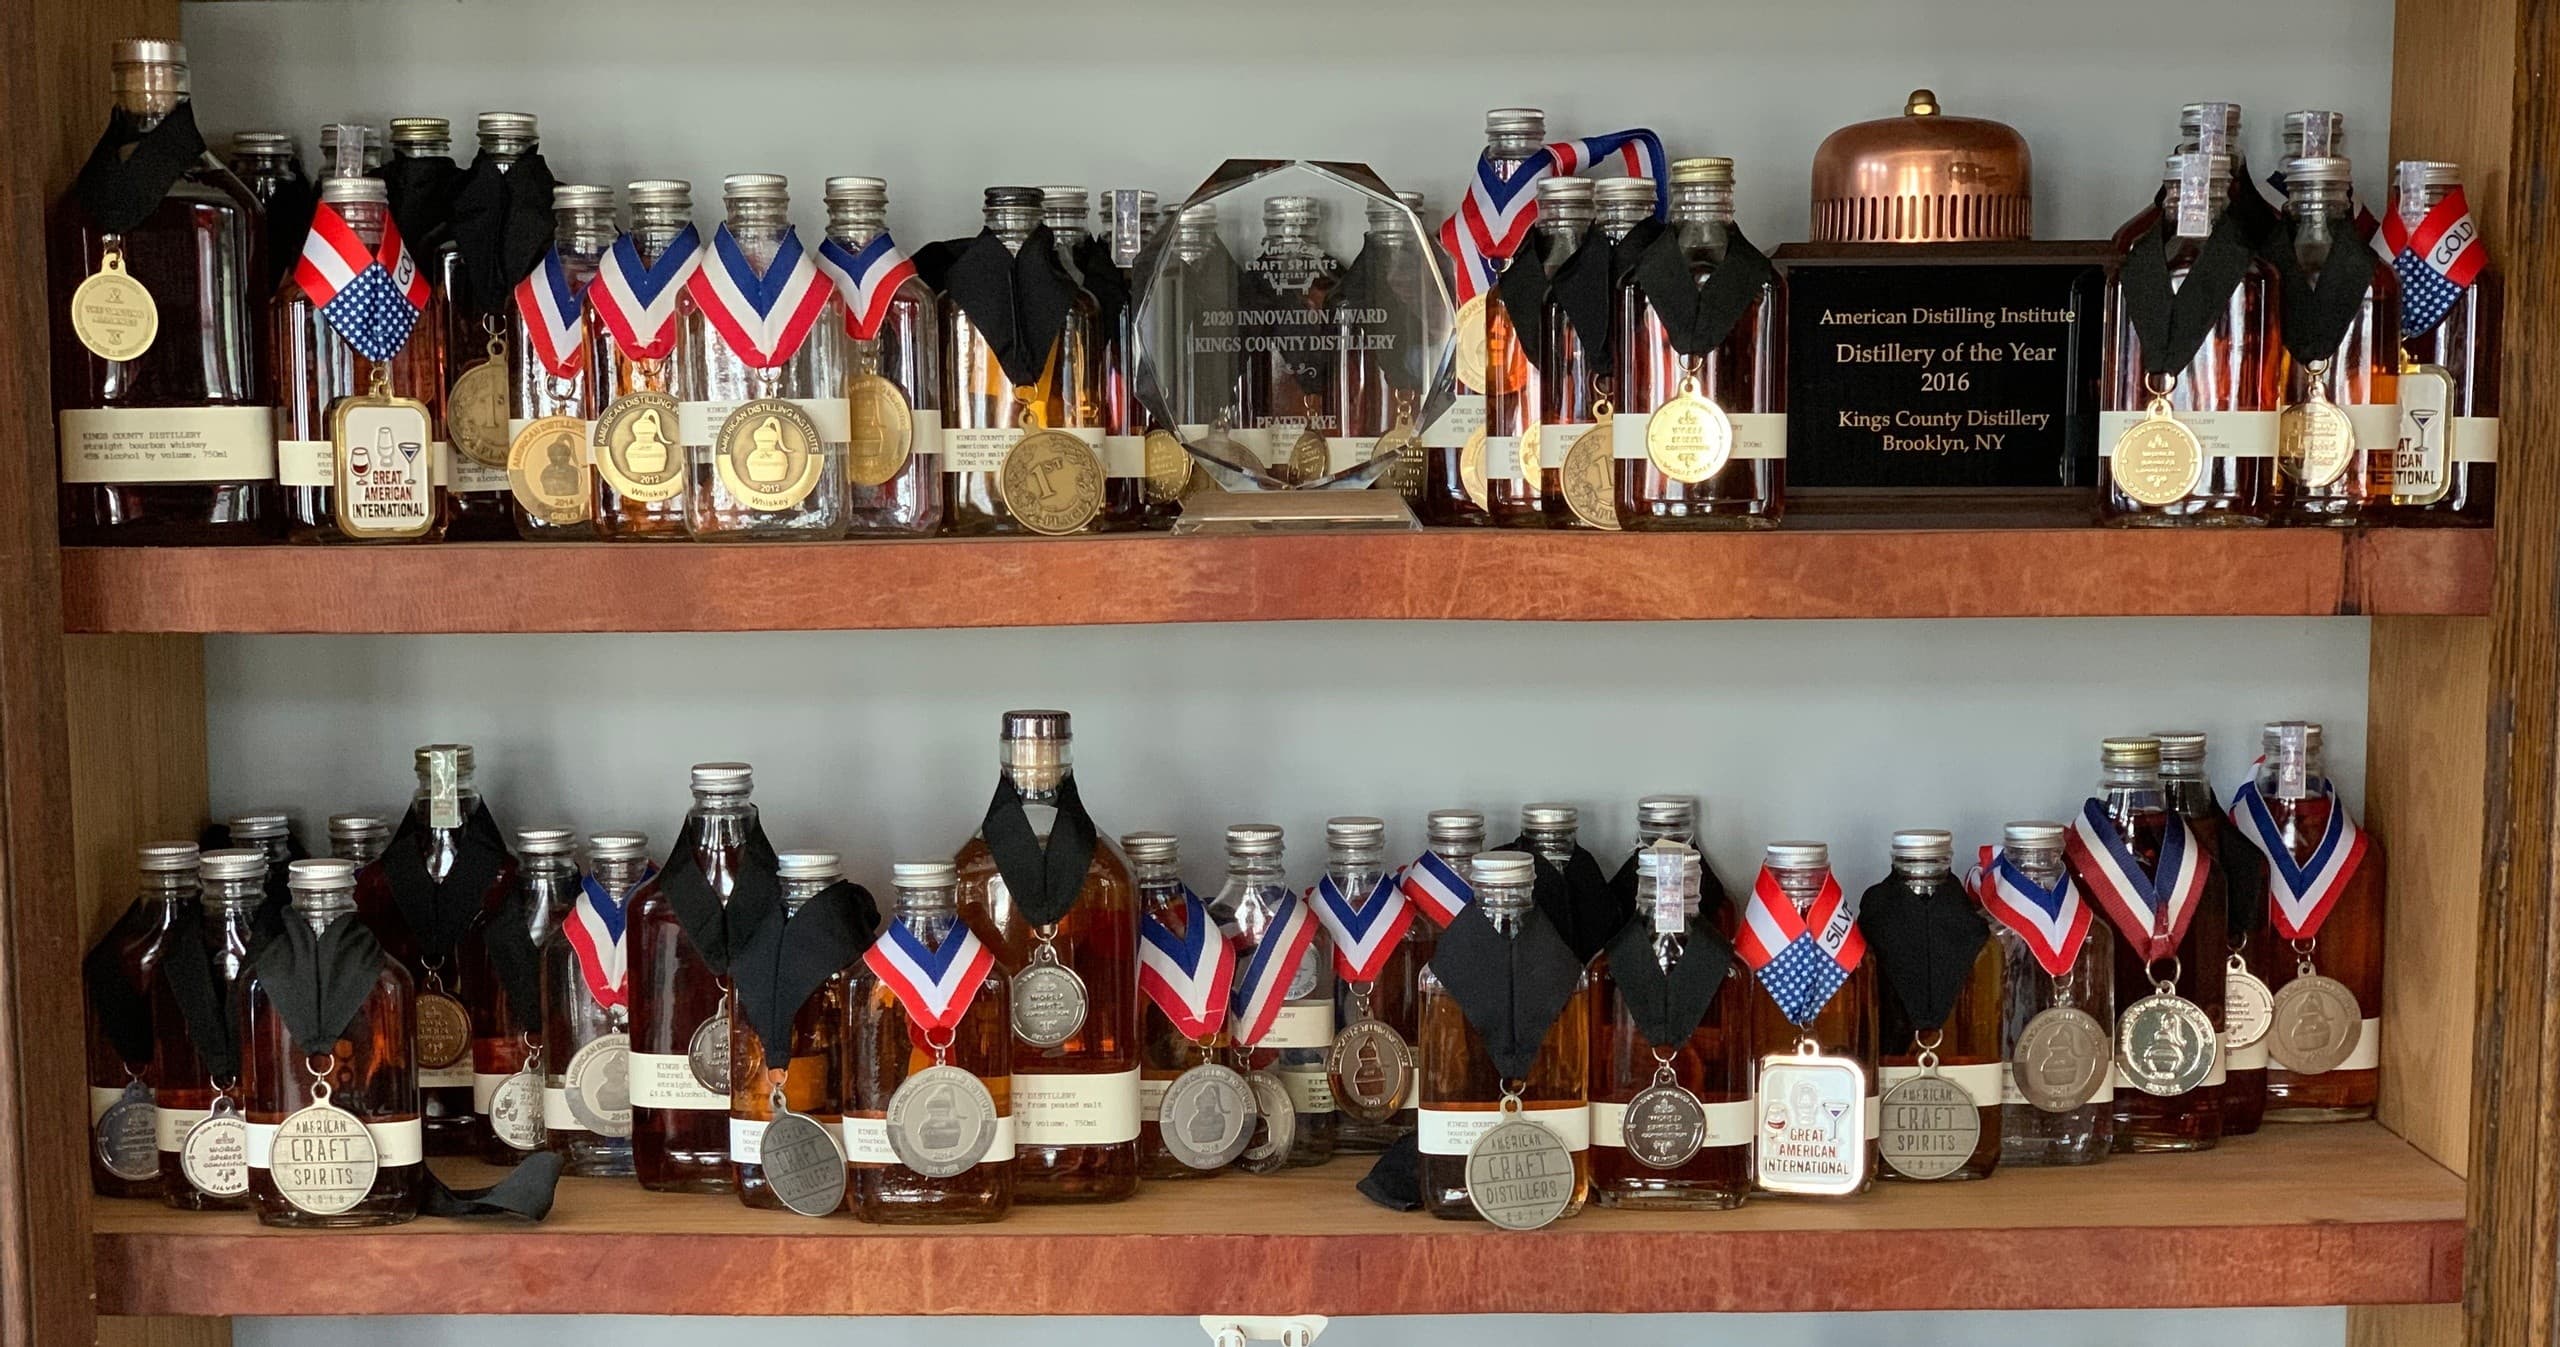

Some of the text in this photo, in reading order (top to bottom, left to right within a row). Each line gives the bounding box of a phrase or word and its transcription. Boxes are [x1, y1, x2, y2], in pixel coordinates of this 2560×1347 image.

[1262, 239, 1325, 258] American
[2435, 221, 2474, 265] GOLD
[1245, 259, 1338, 271] CRAFT SPIRITS
[1263, 271, 1321, 280] ASSOCIATION
[1202, 308, 1388, 327] 2020 INNOVATION AWARD
[1819, 306, 2076, 329] American Distilling Institute
[1194, 334, 1397, 352] KINGS COUNTY DISTILLERY
[1836, 342, 2057, 368] Distillery of the Year
[1920, 371, 1971, 392] 2016
[598, 396, 673, 444] AMERICAN DISTILLING
[1256, 415, 1337, 430] PEATED RYE
[1838, 409, 2051, 431] Kings County Distillery
[82, 431, 202, 440] KINGS COUNTY DISTILLERY
[720, 411, 748, 453] AMERICAN
[747, 403, 794, 417] DISTILLING
[792, 411, 820, 453] INSTITUTE
[83, 441, 207, 451] straight bourbon whiskey
[1882, 433, 2006, 455] Brooklyn, NY
[104, 452, 140, 460] alcohol
[145, 451, 155, 461] by
[160, 451, 196, 460] volume,
[202, 450, 228, 458] 750ml
[2395, 453, 2423, 468] ICAN
[372, 470, 402, 485] GREAT
[640, 474, 660, 484] 2012
[364, 486, 412, 501] AMERICAN
[631, 487, 669, 498] Whiskey
[760, 483, 780, 492] 2012
[752, 496, 789, 506] Whiskey
[352, 502, 425, 519] INTERNATIONAL
[550, 510, 578, 521] GOLD
[1825, 902, 1854, 950] SILV
[1030, 993, 1064, 1001] WORLD
[571, 1036, 630, 1086] AMERICAN DISTILL
[656, 1063, 680, 1071] KINGS
[656, 1071, 684, 1079] barrel
[657, 1081, 692, 1090] straight
[675, 1090, 708, 1098] alcohol
[1902, 1087, 1953, 1102] AMERICAN
[1028, 1101, 1047, 1109] from
[1050, 1101, 1080, 1110] peated
[1083, 1101, 1102, 1109] malt
[1022, 1119, 1031, 1128] by
[1036, 1119, 1069, 1128] volume,
[1896, 1106, 1956, 1130] CRAFT
[295, 1119, 347, 1134] AMERICAN
[604, 1125, 632, 1134] SILVE
[1491, 1133, 1542, 1150] AMERICAN
[1790, 1128, 1825, 1142] GREAT
[209, 1145, 242, 1153] WORLD
[291, 1138, 351, 1162] CRAFT
[1897, 1134, 1956, 1152] SPIRITS
[776, 1140, 820, 1174] CRAFT
[1779, 1144, 1837, 1159] AMERICAN
[1487, 1151, 1547, 1181] CRAFT
[1764, 1158, 1849, 1177] INTERNATIONAL
[294, 1167, 353, 1186] SPIRITS
[1486, 1180, 1558, 1205] DISTILLERS
